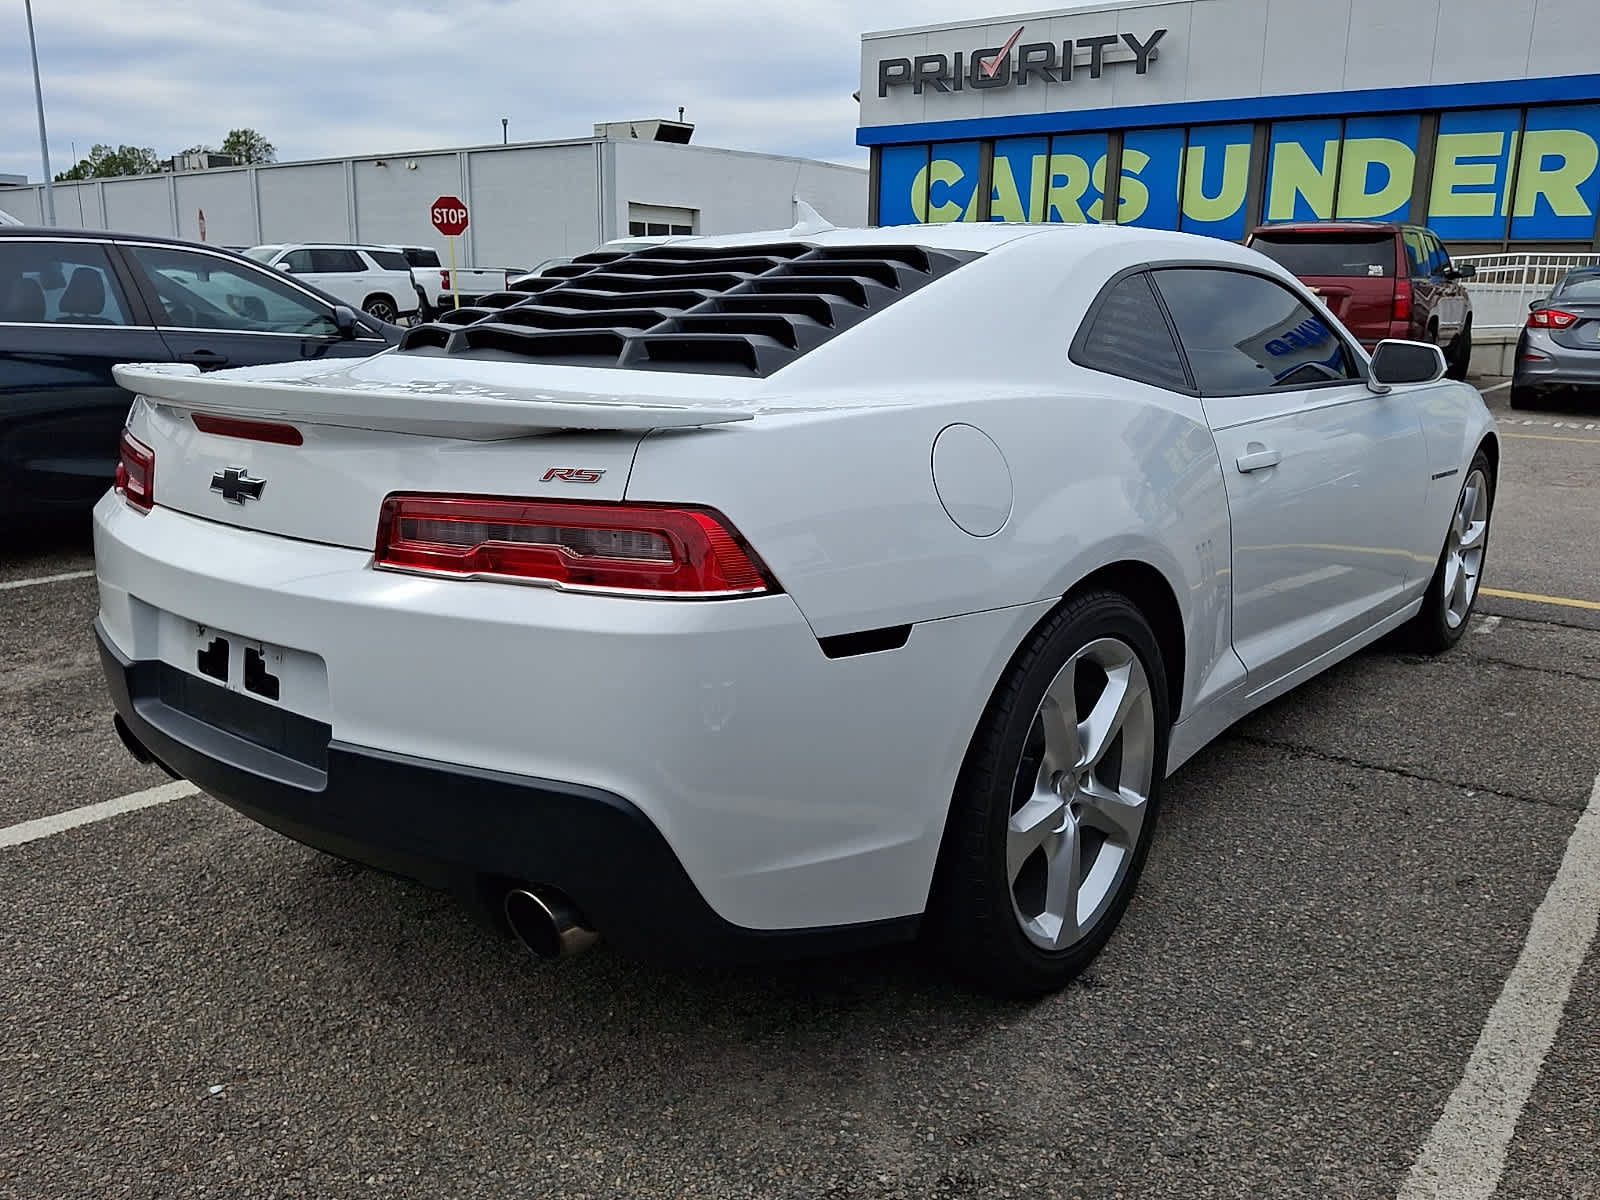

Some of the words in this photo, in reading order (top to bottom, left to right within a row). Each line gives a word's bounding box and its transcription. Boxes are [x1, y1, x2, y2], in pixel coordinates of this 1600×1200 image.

[878, 29, 1167, 98] PRIORITY
[911, 149, 1151, 225] CARS
[1176, 129, 1599, 222] UNDER
[433, 208, 467, 225] STOP
[539, 467, 607, 483] RS
